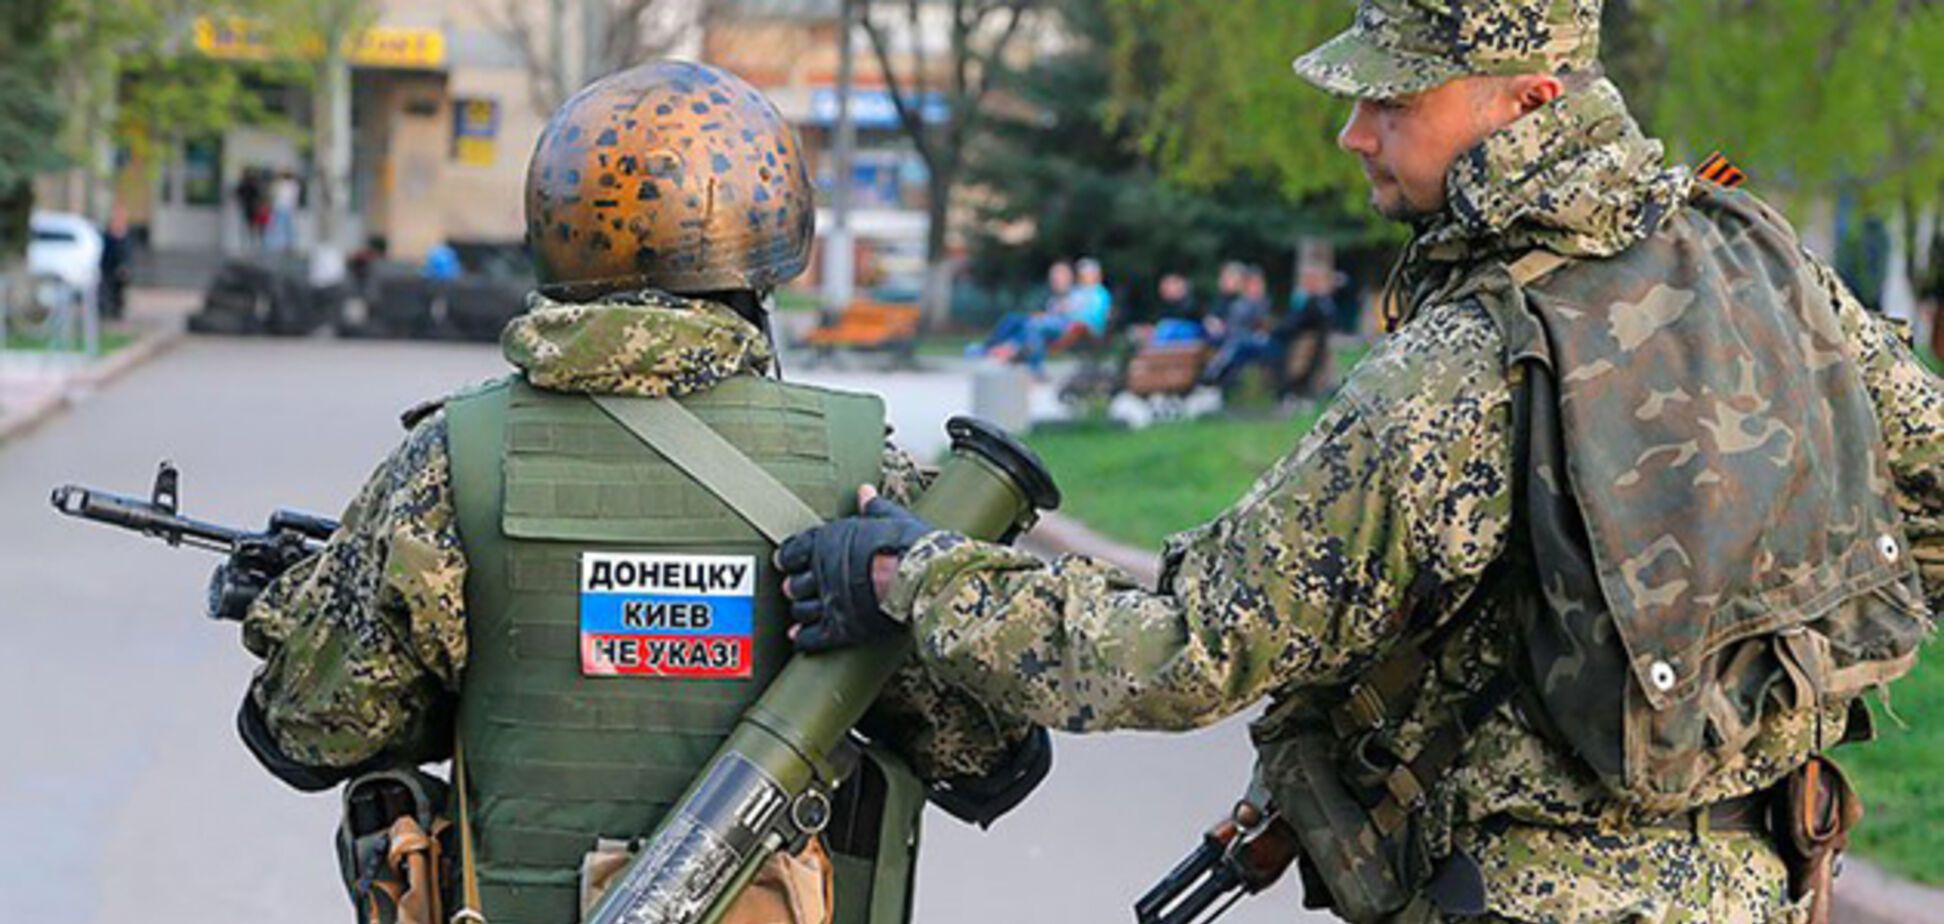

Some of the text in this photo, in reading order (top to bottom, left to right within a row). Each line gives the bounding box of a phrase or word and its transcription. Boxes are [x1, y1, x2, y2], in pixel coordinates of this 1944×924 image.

[588, 560, 747, 592] ДОНЕЦКУ
[623, 601, 712, 628] КИЕВ
[595, 639, 739, 667] НЕ УКАЗ!
